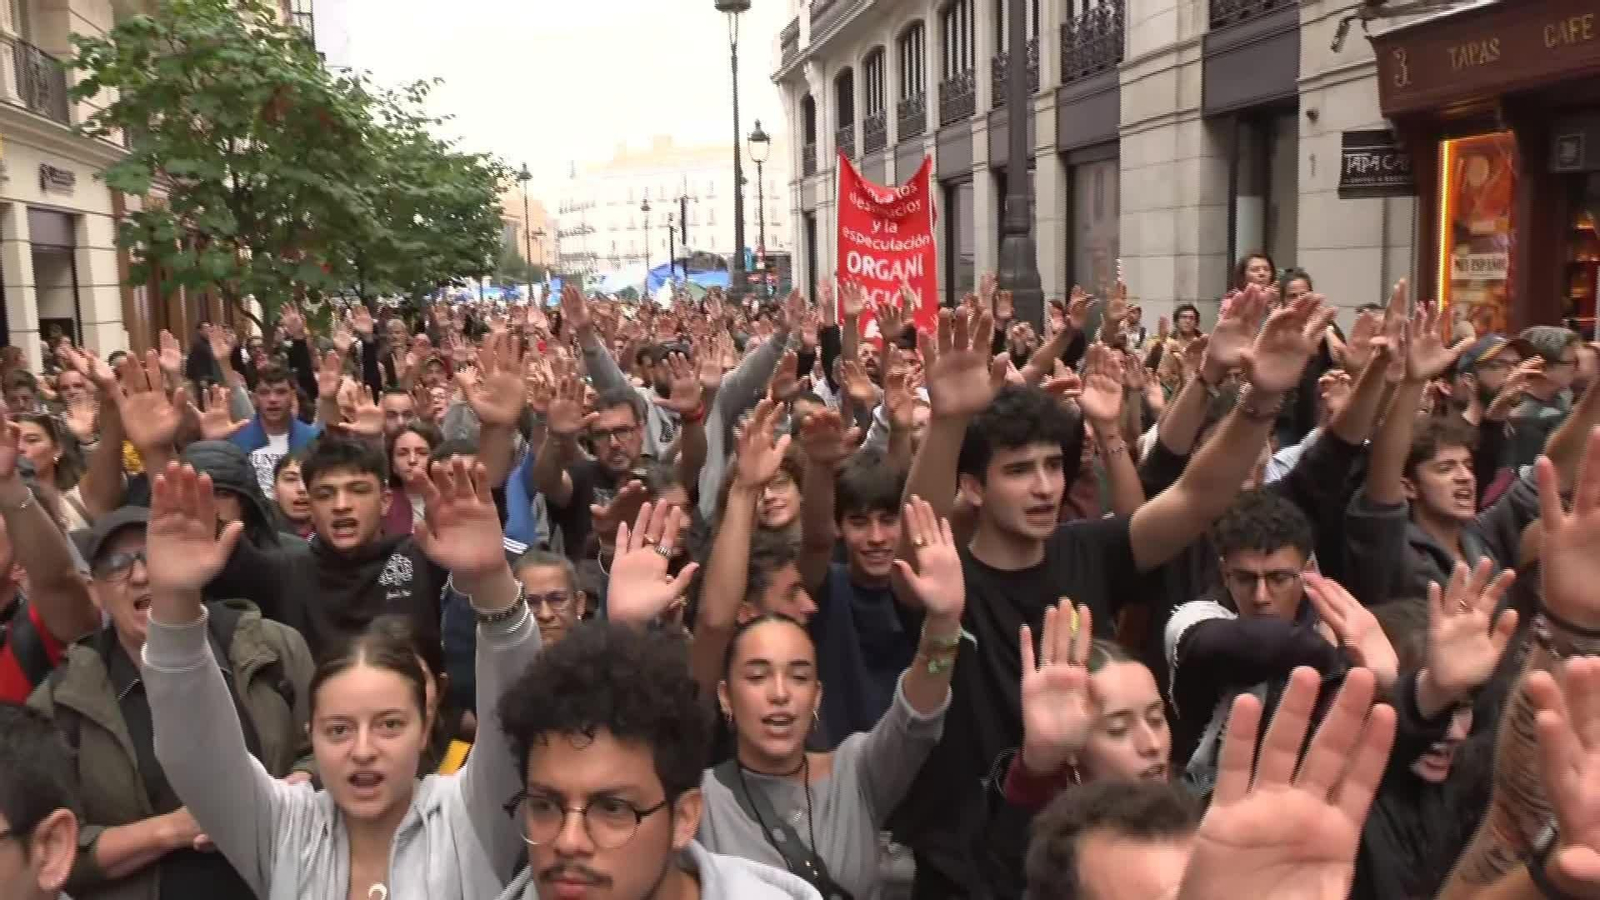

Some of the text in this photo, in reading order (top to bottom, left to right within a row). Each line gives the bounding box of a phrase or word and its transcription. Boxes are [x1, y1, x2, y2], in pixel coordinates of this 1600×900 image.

[1448, 37, 1500, 69] TAPAS
[842, 226, 931, 251] especulación
[870, 218, 898, 234] y la
[846, 250, 924, 281] ORGANI
